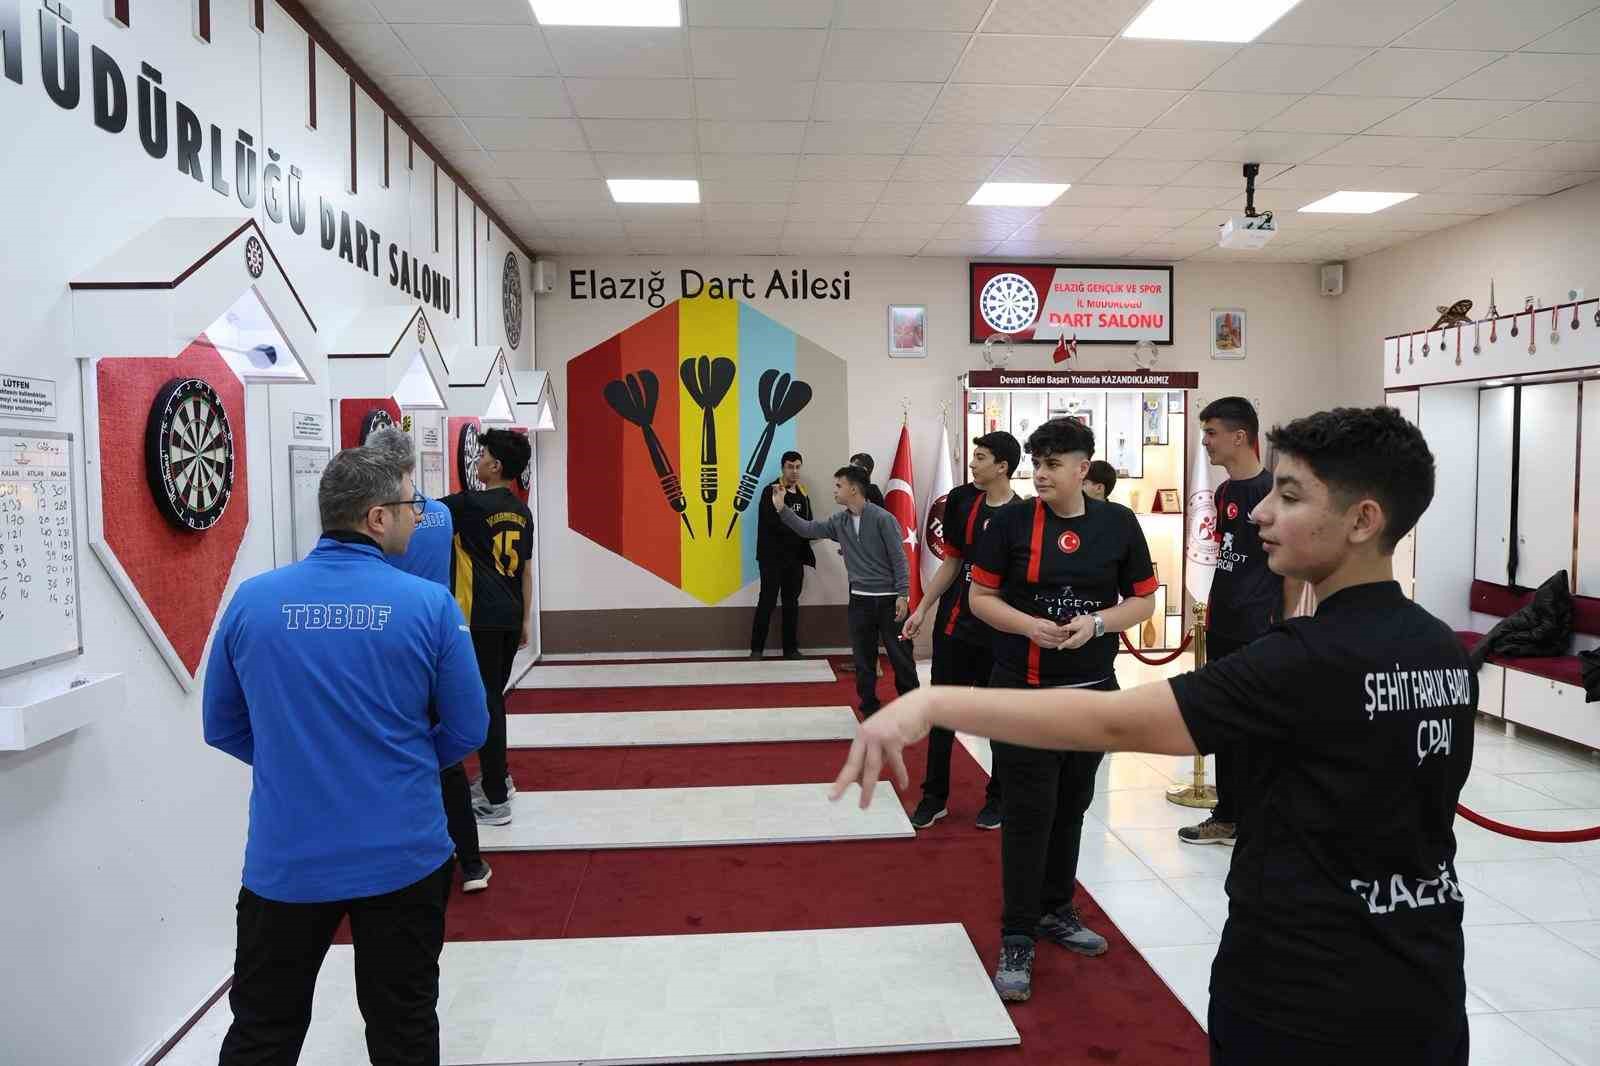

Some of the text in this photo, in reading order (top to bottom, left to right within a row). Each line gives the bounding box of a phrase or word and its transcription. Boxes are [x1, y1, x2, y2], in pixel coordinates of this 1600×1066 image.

[319, 195, 381, 277] DART
[388, 243, 452, 315] SALONU
[569, 269, 851, 309] Elazığ Dart Ailesi
[1127, 283, 1137, 293] VE
[1140, 283, 1162, 294] SPOR
[1049, 313, 1164, 328] DART SALONU
[2, 378, 30, 389] LÜTFEN
[1000, 376, 1026, 385] Devam
[1027, 376, 1046, 385] Eden
[1072, 376, 1100, 385] Yolunda
[1101, 376, 1169, 385] KAZANDIKLARIMIZ
[492, 530, 521, 577] 15
[281, 603, 392, 631] TBBDF
[1364, 662, 1410, 721] ŞEHİT
[1411, 669, 1451, 709] FARUK
